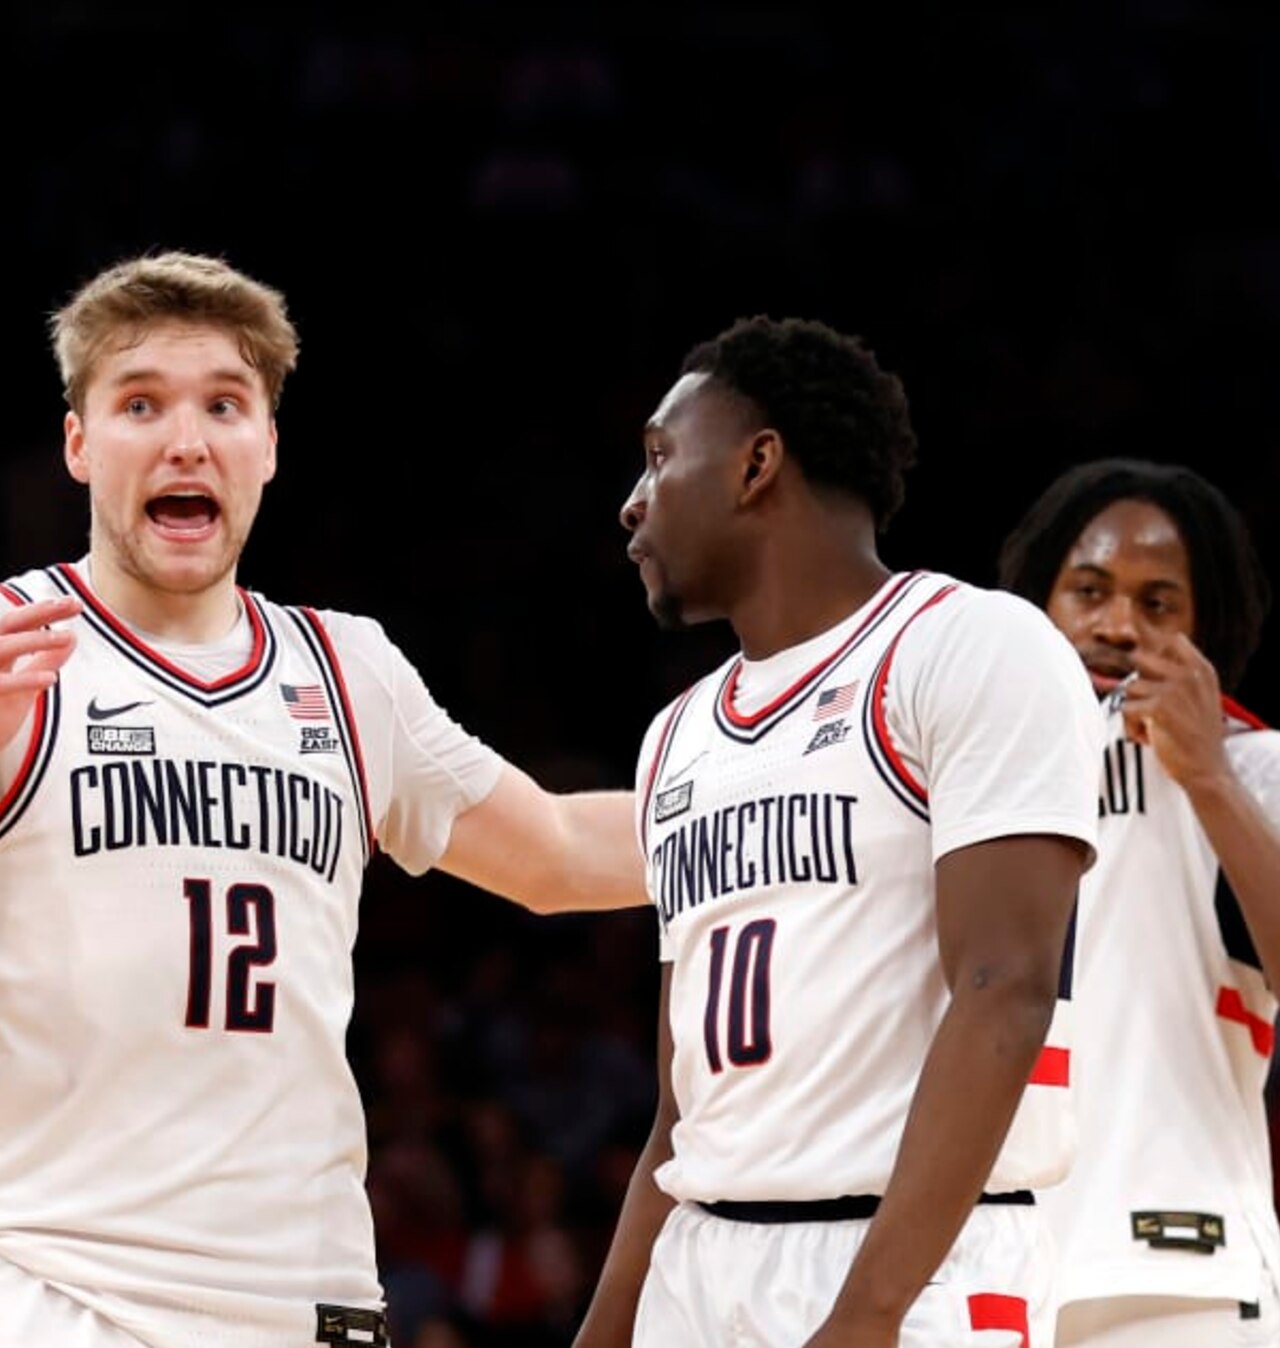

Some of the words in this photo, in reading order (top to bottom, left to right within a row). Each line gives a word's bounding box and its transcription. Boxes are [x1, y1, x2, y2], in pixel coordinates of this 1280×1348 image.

[70, 759, 343, 883] CONNECTICUT
[183, 877, 277, 1033] 12
[704, 918, 776, 1074] 10
